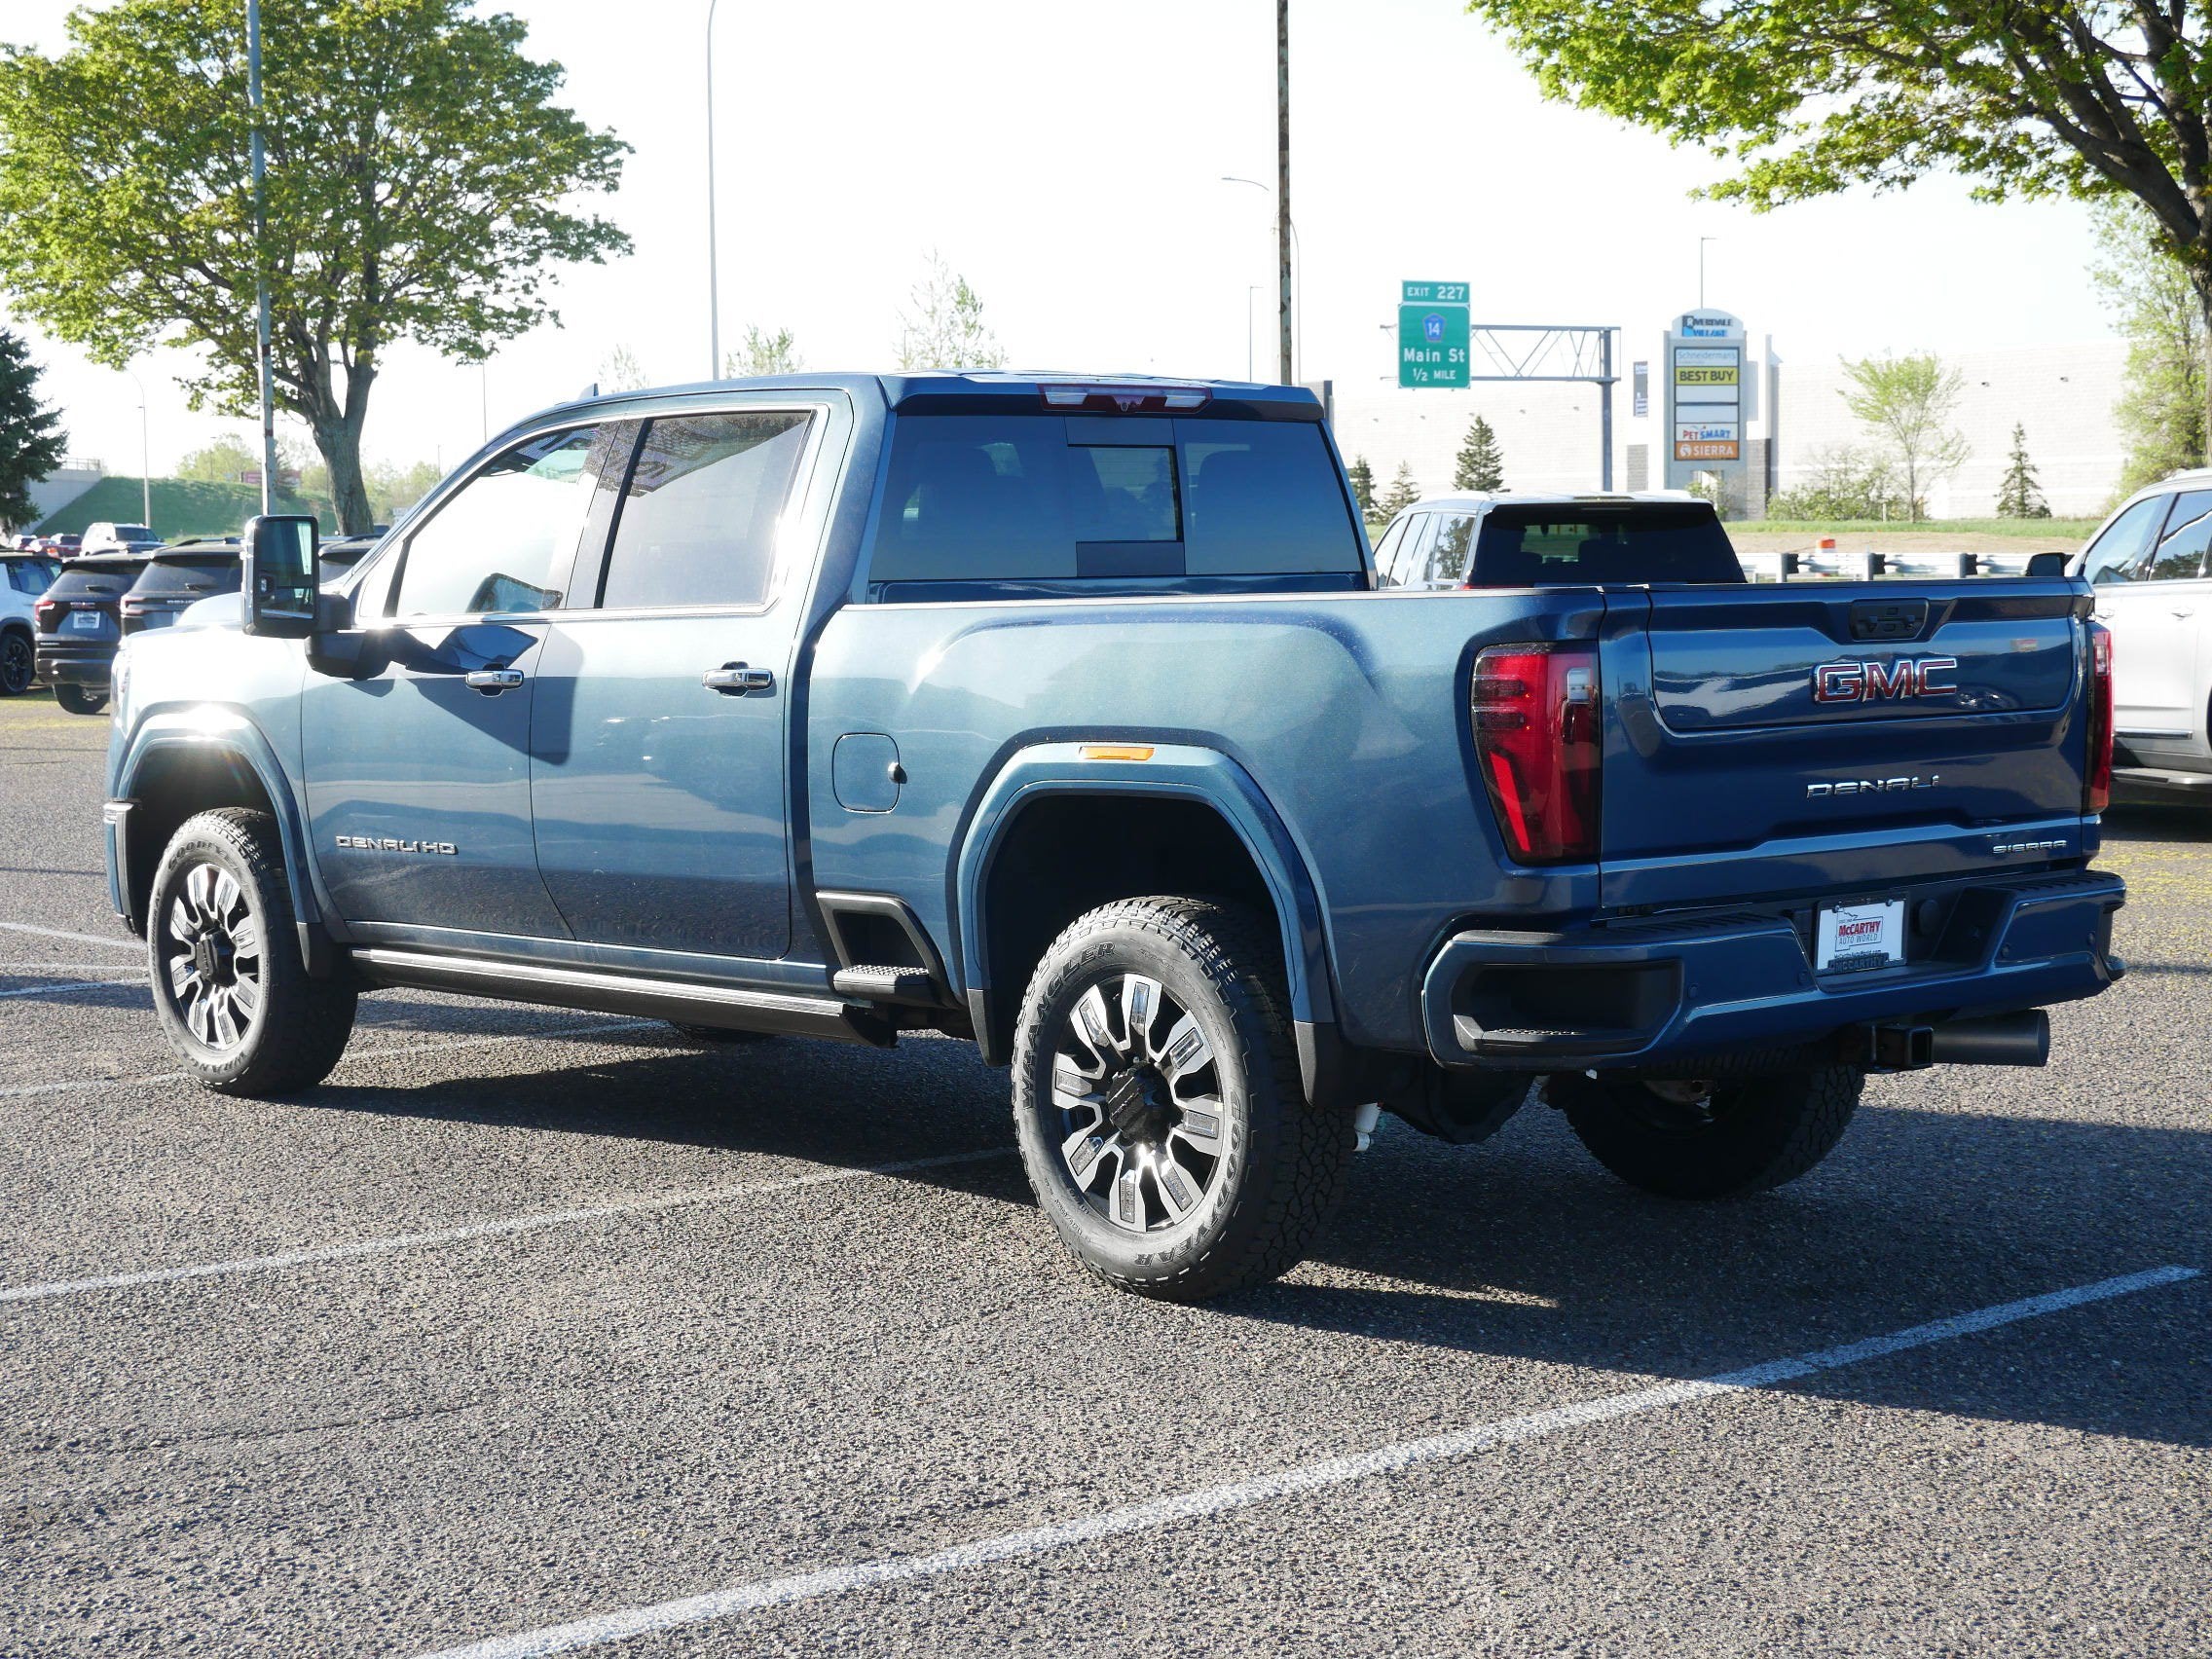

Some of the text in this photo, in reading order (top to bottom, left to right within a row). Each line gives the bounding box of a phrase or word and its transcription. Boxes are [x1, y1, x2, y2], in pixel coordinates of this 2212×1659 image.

[1407, 285, 1465, 300] EXIT 227
[1428, 322, 1441, 336] 14
[1404, 348, 1465, 362] Main St
[1433, 370, 1456, 380] MILE
[1679, 370, 1734, 382] BEST BUY
[1693, 445, 1733, 457] SIERRA
[1814, 657, 1957, 704] GMC
[1807, 775, 1939, 798] DENALI
[335, 835, 459, 855] DENALI HD
[1992, 839, 2067, 854] SIERRA
[1838, 920, 1881, 938] McCARTHY
[1839, 933, 1878, 945] AUTO WORLD
[1021, 941, 1116, 1110] WRANGLER
[1134, 1090, 1241, 1267] GOODYEAR
